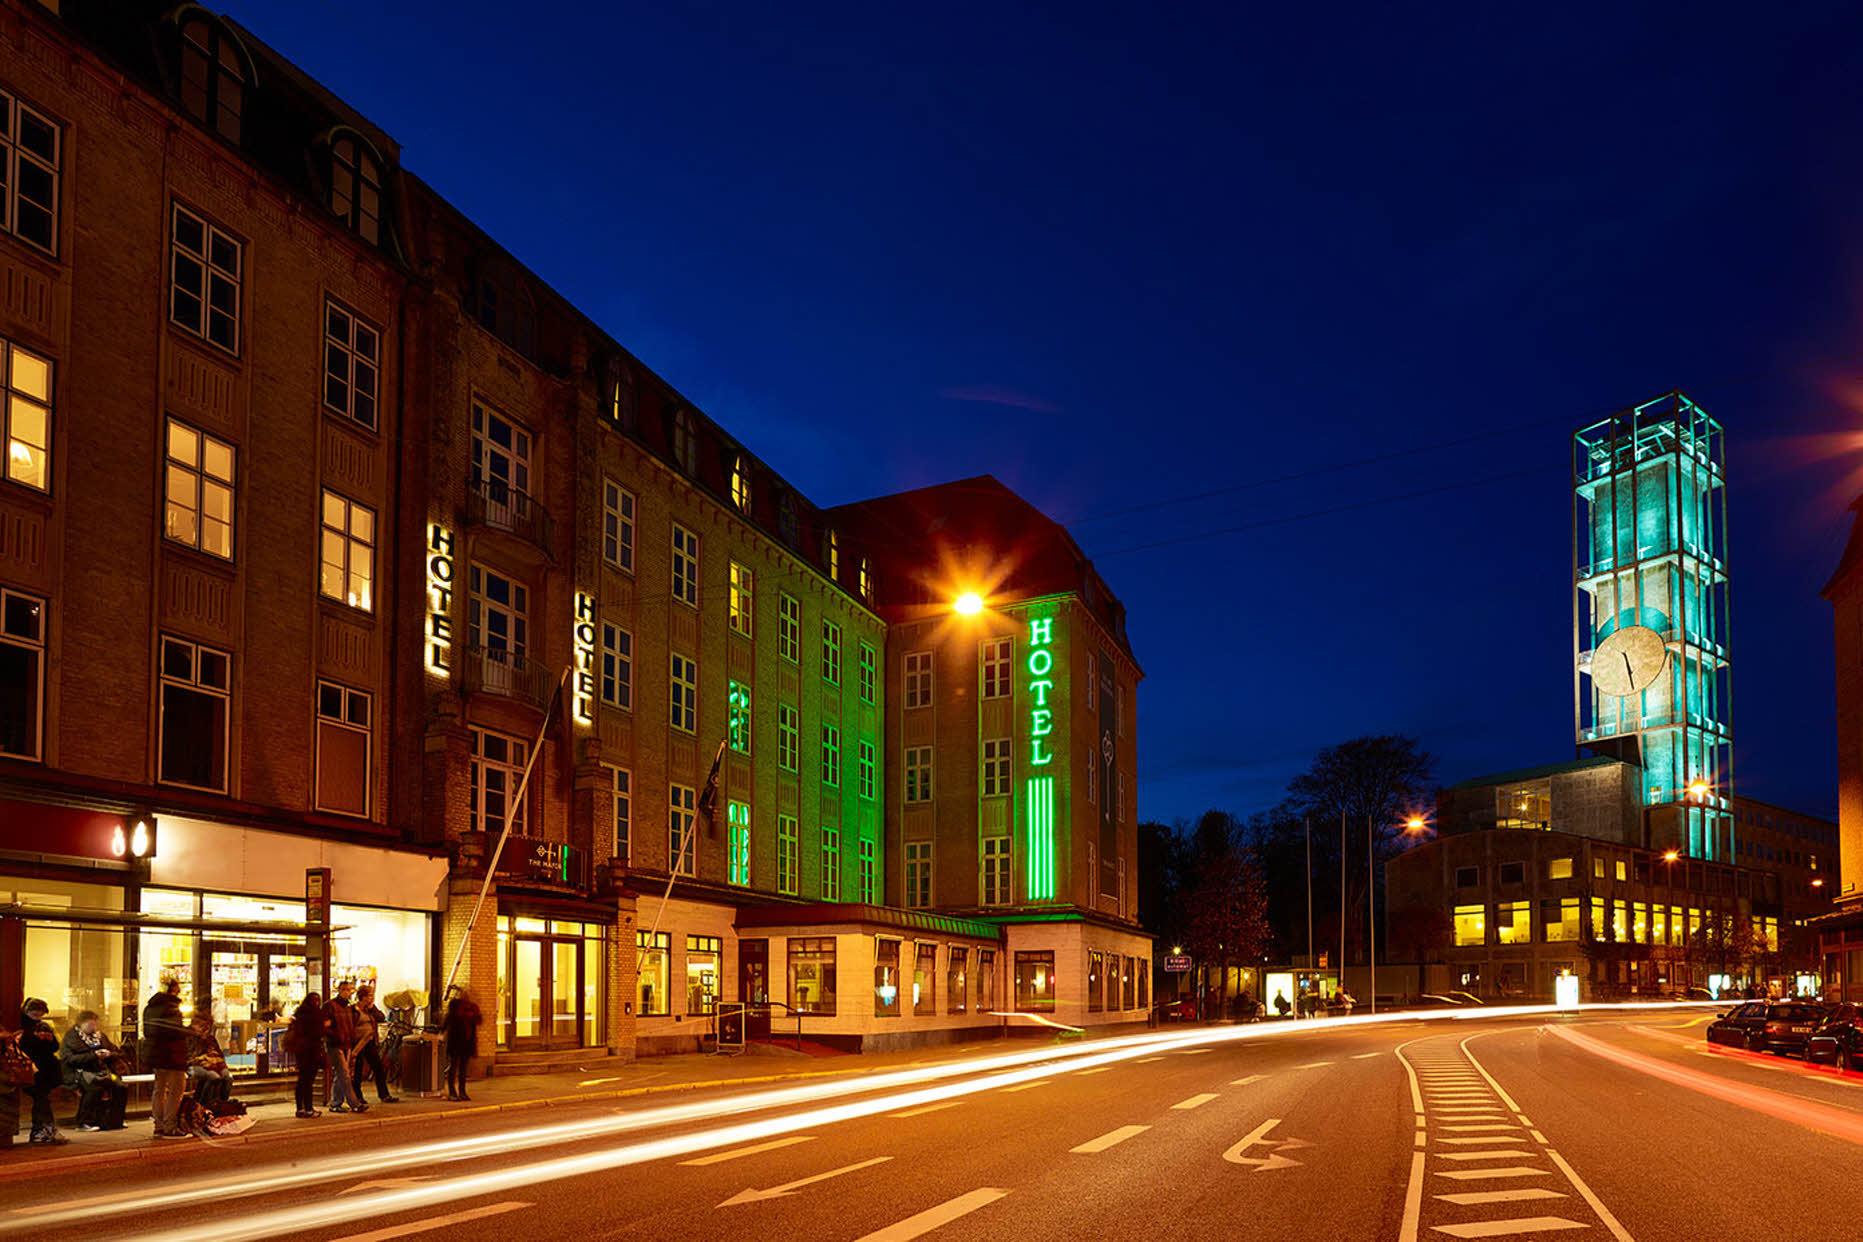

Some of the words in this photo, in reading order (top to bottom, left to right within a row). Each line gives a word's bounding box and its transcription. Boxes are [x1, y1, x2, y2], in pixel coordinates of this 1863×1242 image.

[430, 525, 455, 672] HOTEL
[576, 593, 596, 721] HOTEL
[1028, 617, 1054, 766] HOTEL
